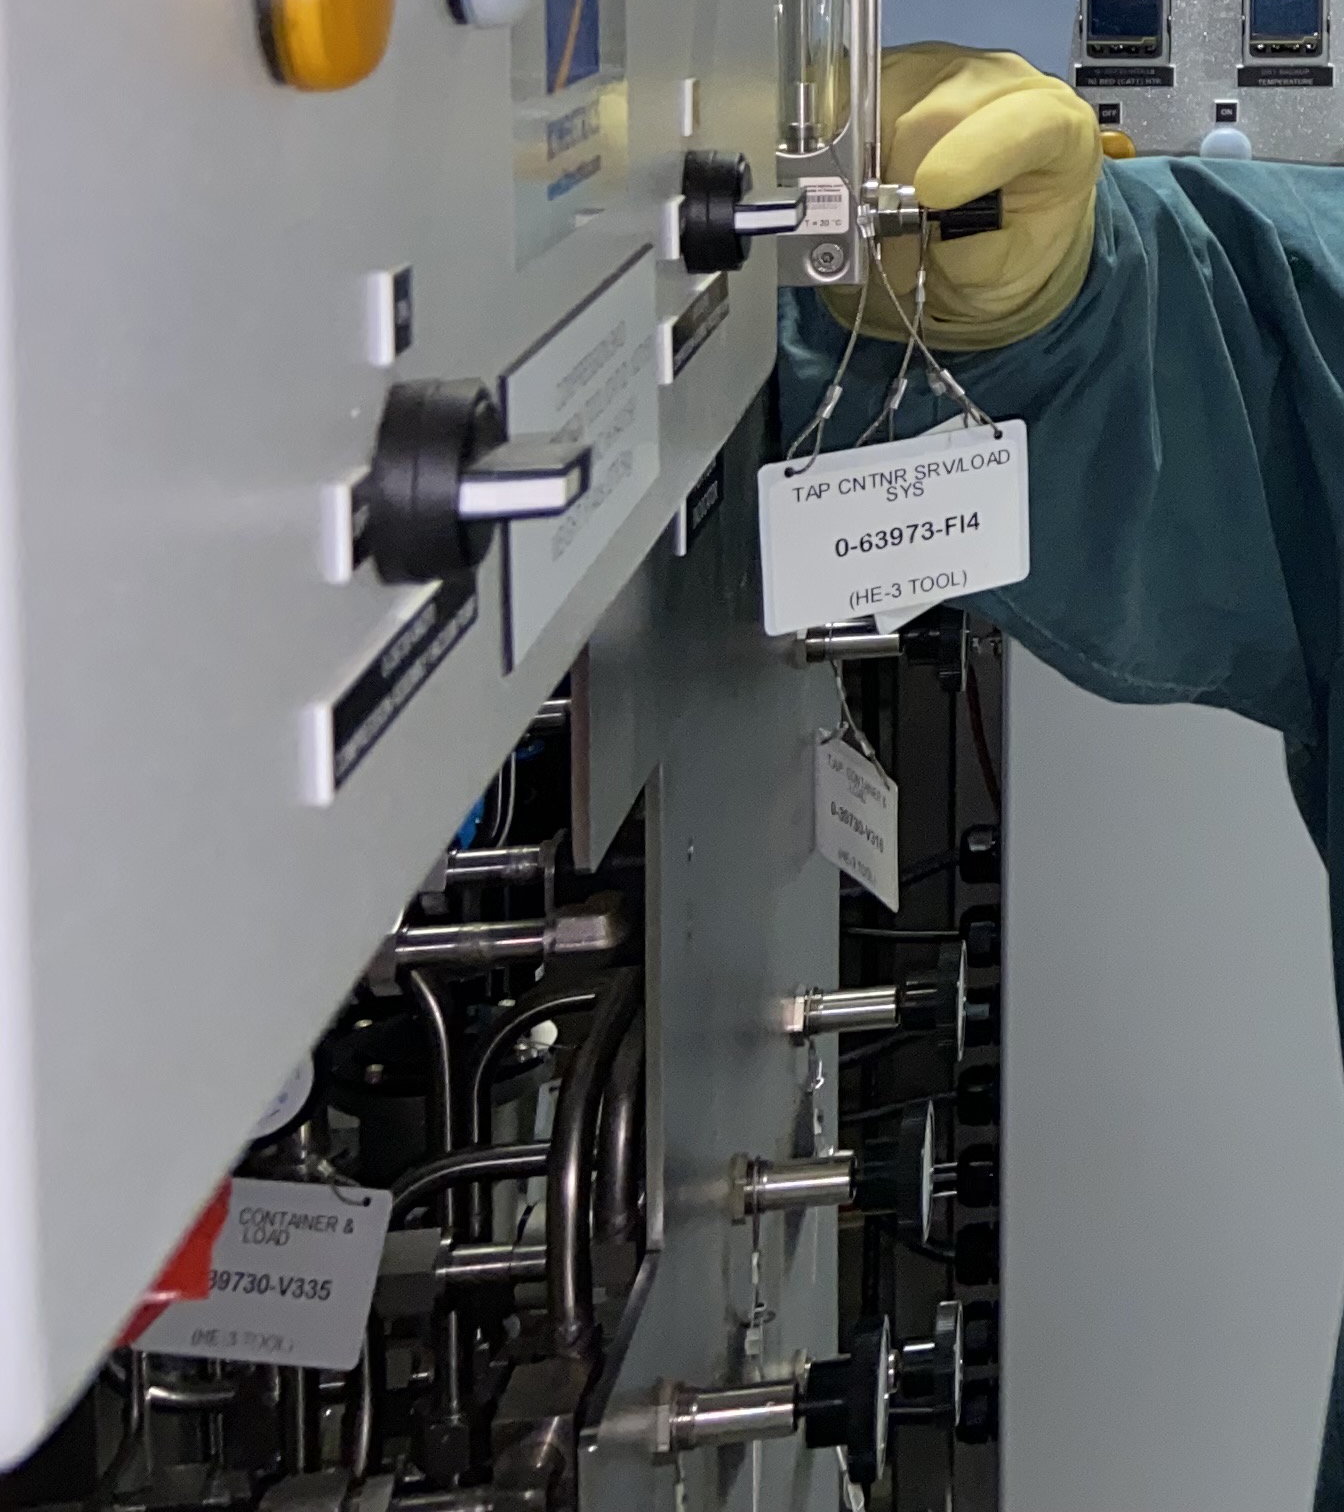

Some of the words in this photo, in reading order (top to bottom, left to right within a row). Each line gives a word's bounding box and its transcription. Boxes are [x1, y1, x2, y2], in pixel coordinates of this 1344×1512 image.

[1258, 77, 1314, 86] TEMPERATURE
[1102, 109, 1116, 117] OFF
[1220, 108, 1233, 116] ON
[792, 482, 831, 503] TAP
[838, 468, 907, 496] CNTNR
[914, 449, 1010, 481] SRV/LOAD
[886, 481, 925, 502] SYS
[835, 511, 981, 558] 0-63973-FI4
[849, 582, 902, 611] (HE-3
[908, 569, 968, 596] TOOL)
[239, 1207, 339, 1233] CONTAINER
[343, 1218, 354, 1234] &
[241, 1227, 290, 1246] LOAD
